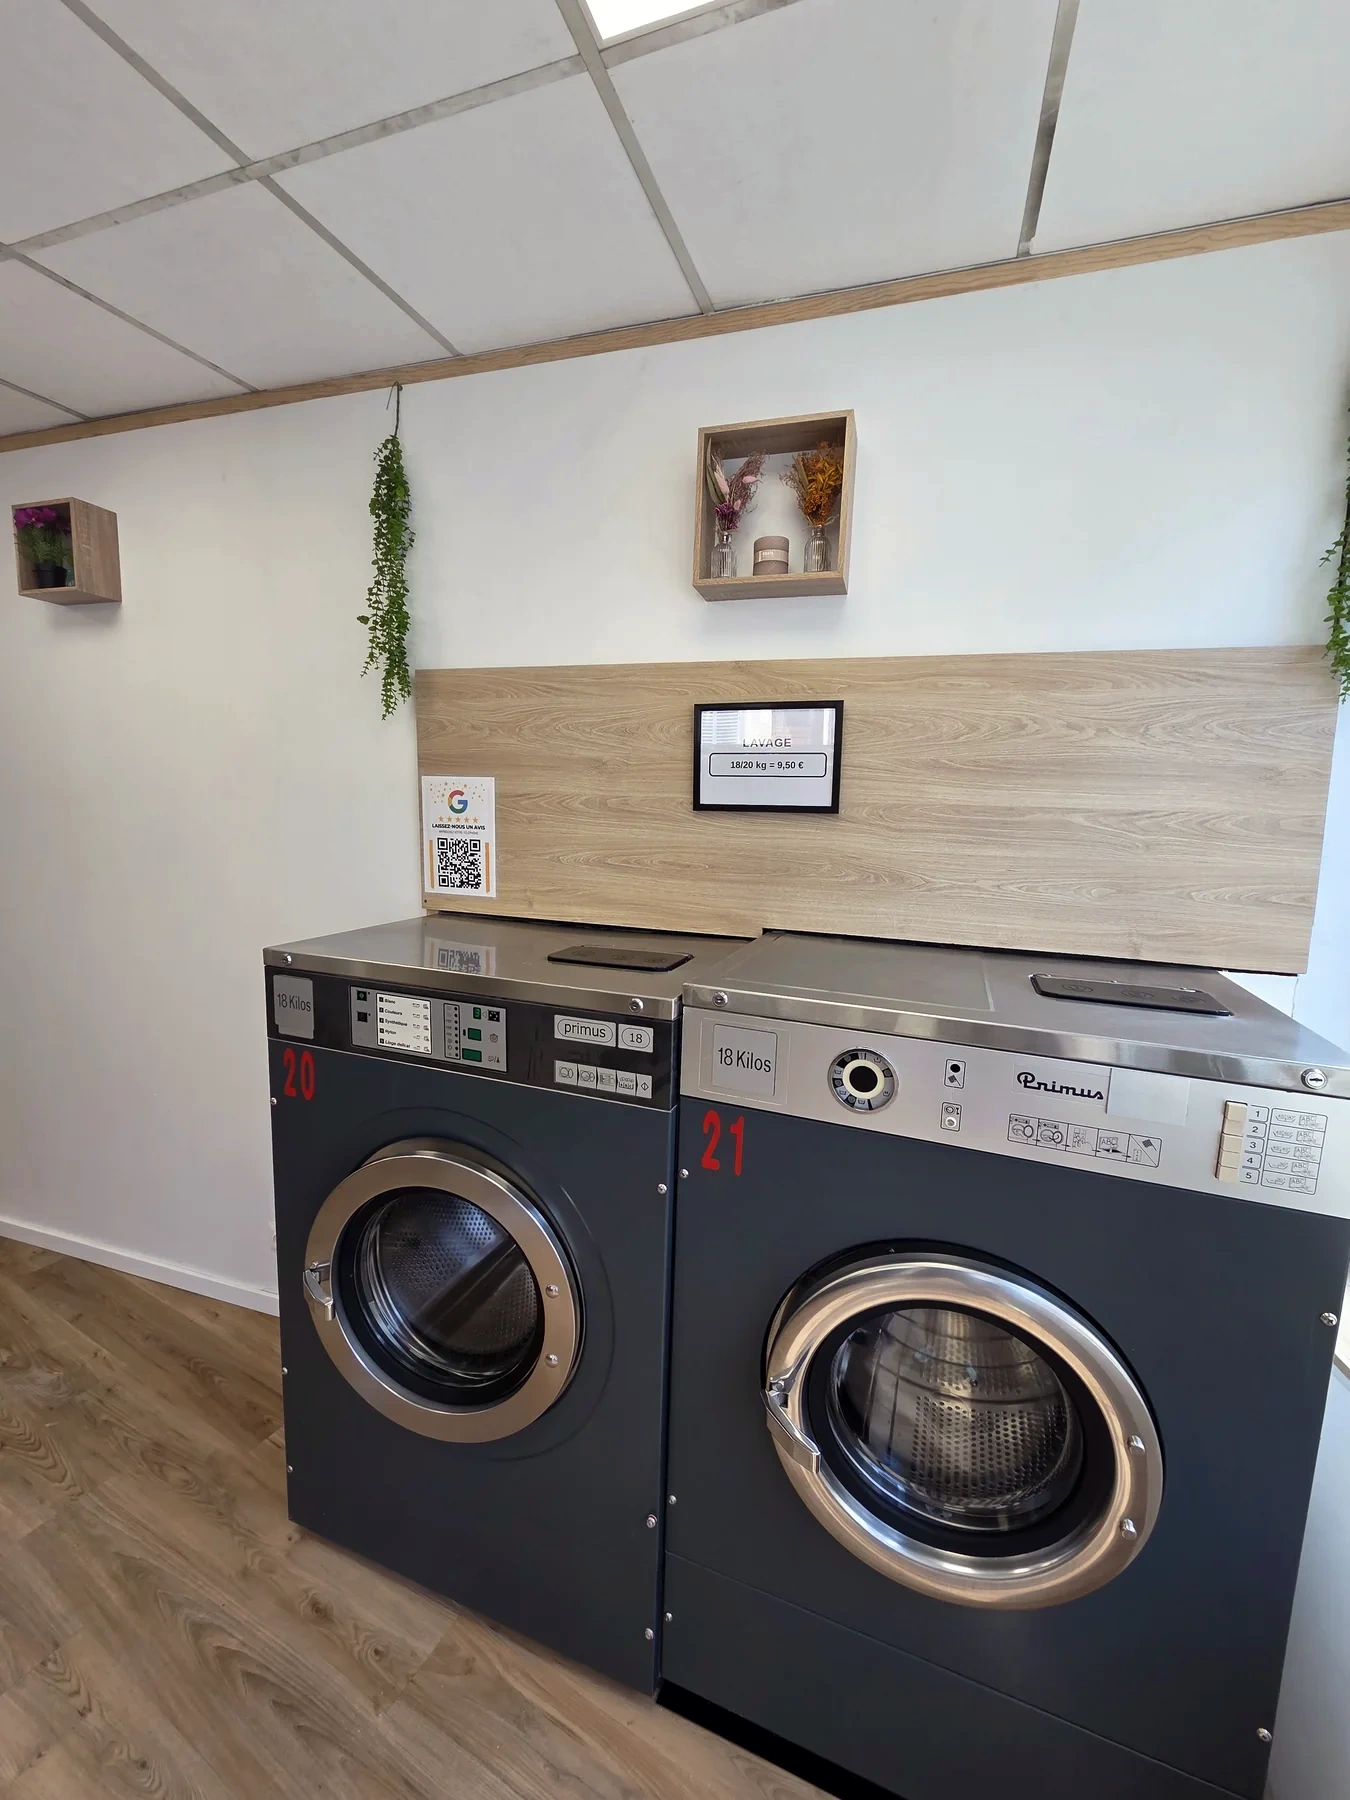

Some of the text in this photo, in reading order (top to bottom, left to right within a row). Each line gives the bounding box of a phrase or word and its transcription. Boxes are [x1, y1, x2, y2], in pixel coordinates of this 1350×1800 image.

[743, 738, 792, 748] LAVAGE
[730, 761, 754, 769] 18/20
[756, 761, 767, 771] kg
[777, 761, 796, 770] 9,50
[276, 993, 311, 1013] 18 Kilos
[564, 1022, 606, 1038] primus
[629, 1033, 643, 1044] 18
[717, 1047, 772, 1074] 18 Kilos
[283, 1047, 315, 1101] 20
[1017, 1071, 1104, 1100] Primus
[701, 1109, 745, 1177] 21
